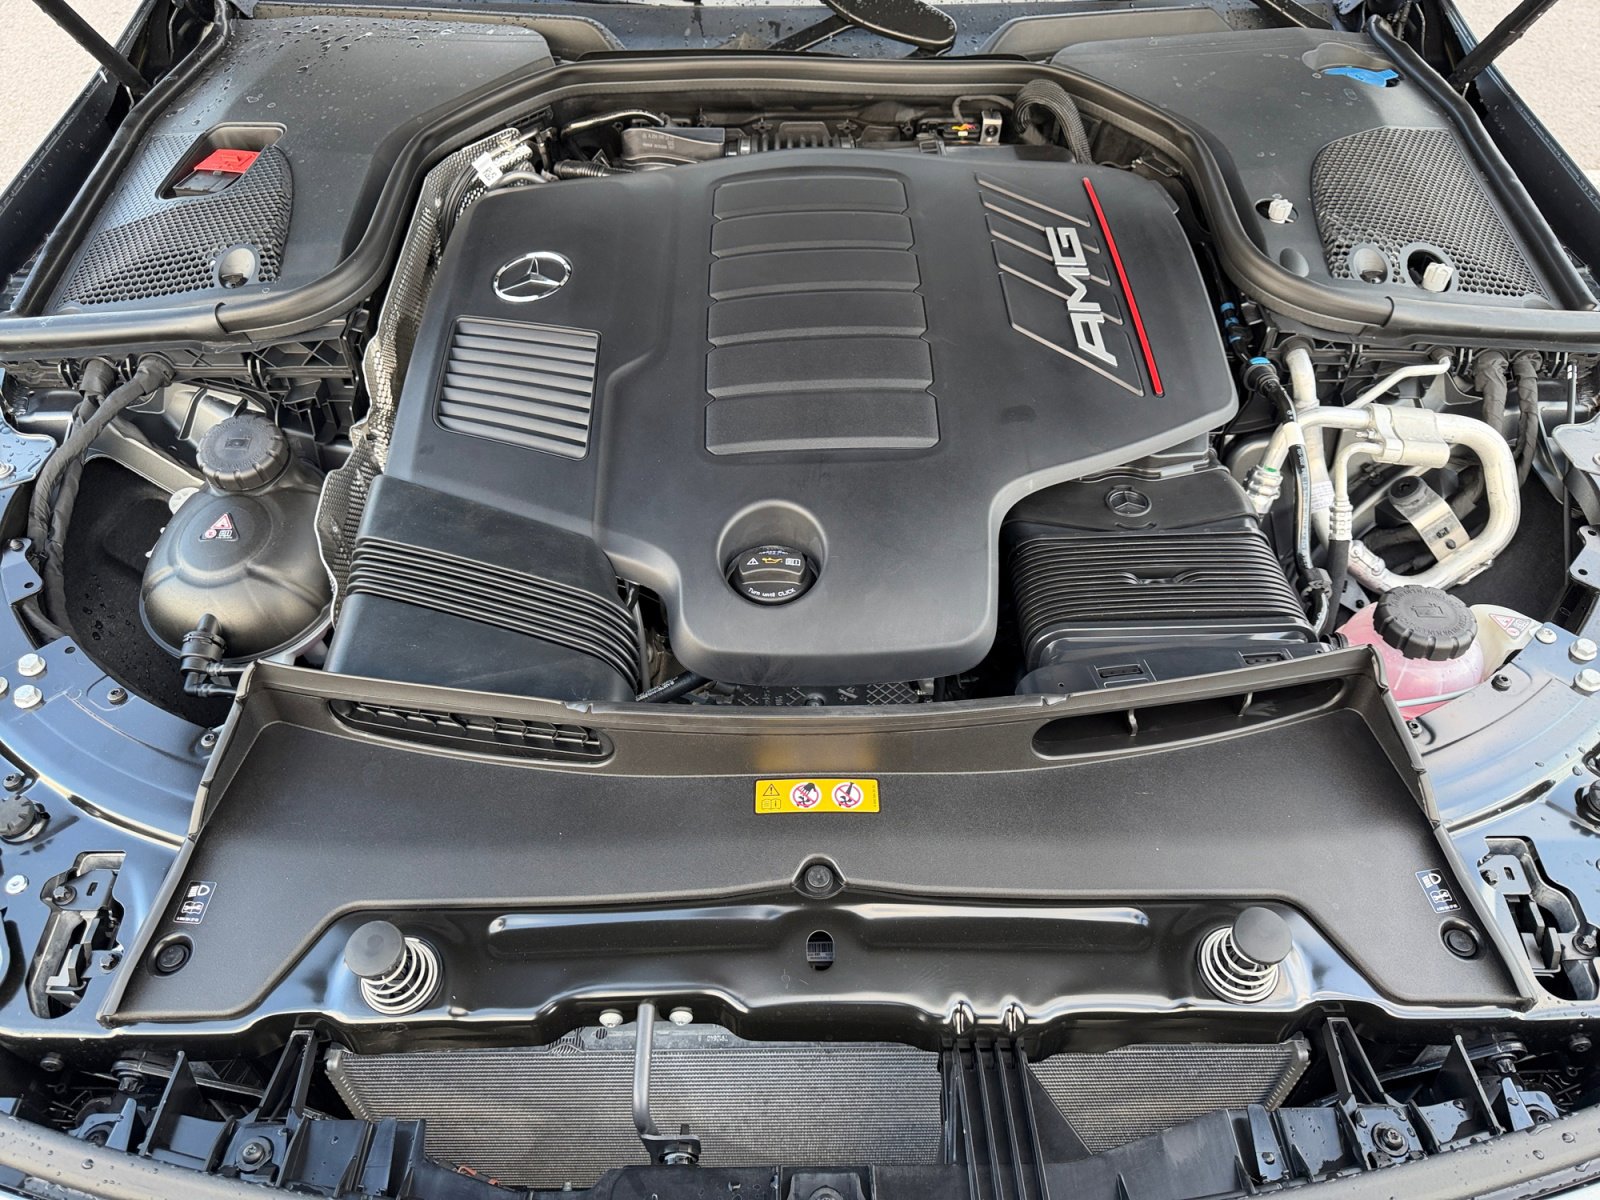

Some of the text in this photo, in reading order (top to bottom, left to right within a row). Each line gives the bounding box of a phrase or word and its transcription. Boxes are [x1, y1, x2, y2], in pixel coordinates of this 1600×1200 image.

[1045, 226, 1118, 367] AMG
[748, 587, 761, 595] Turn
[778, 587, 796, 596] CLICK
